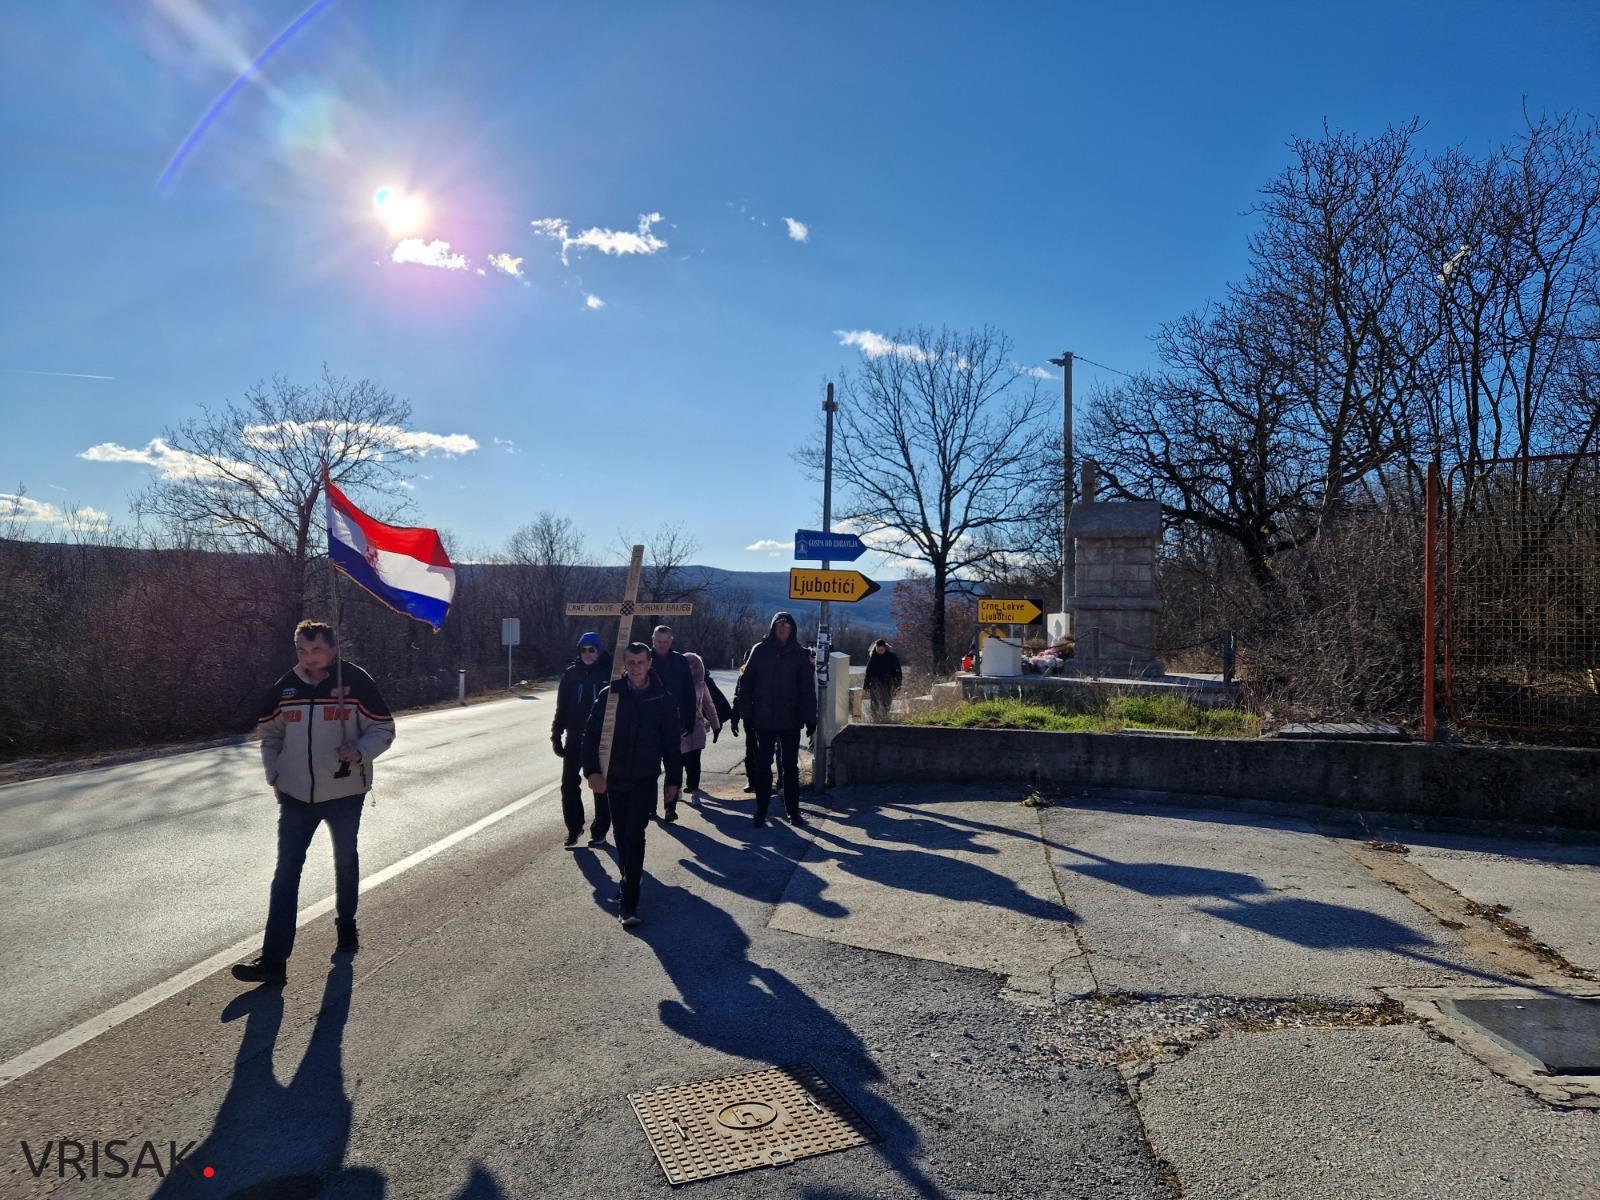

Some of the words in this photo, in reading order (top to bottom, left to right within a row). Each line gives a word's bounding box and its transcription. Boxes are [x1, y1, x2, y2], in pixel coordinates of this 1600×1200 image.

[794, 576, 855, 595] Ljubotići
[981, 602, 999, 611] Crne
[1002, 601, 1025, 611] Lokve
